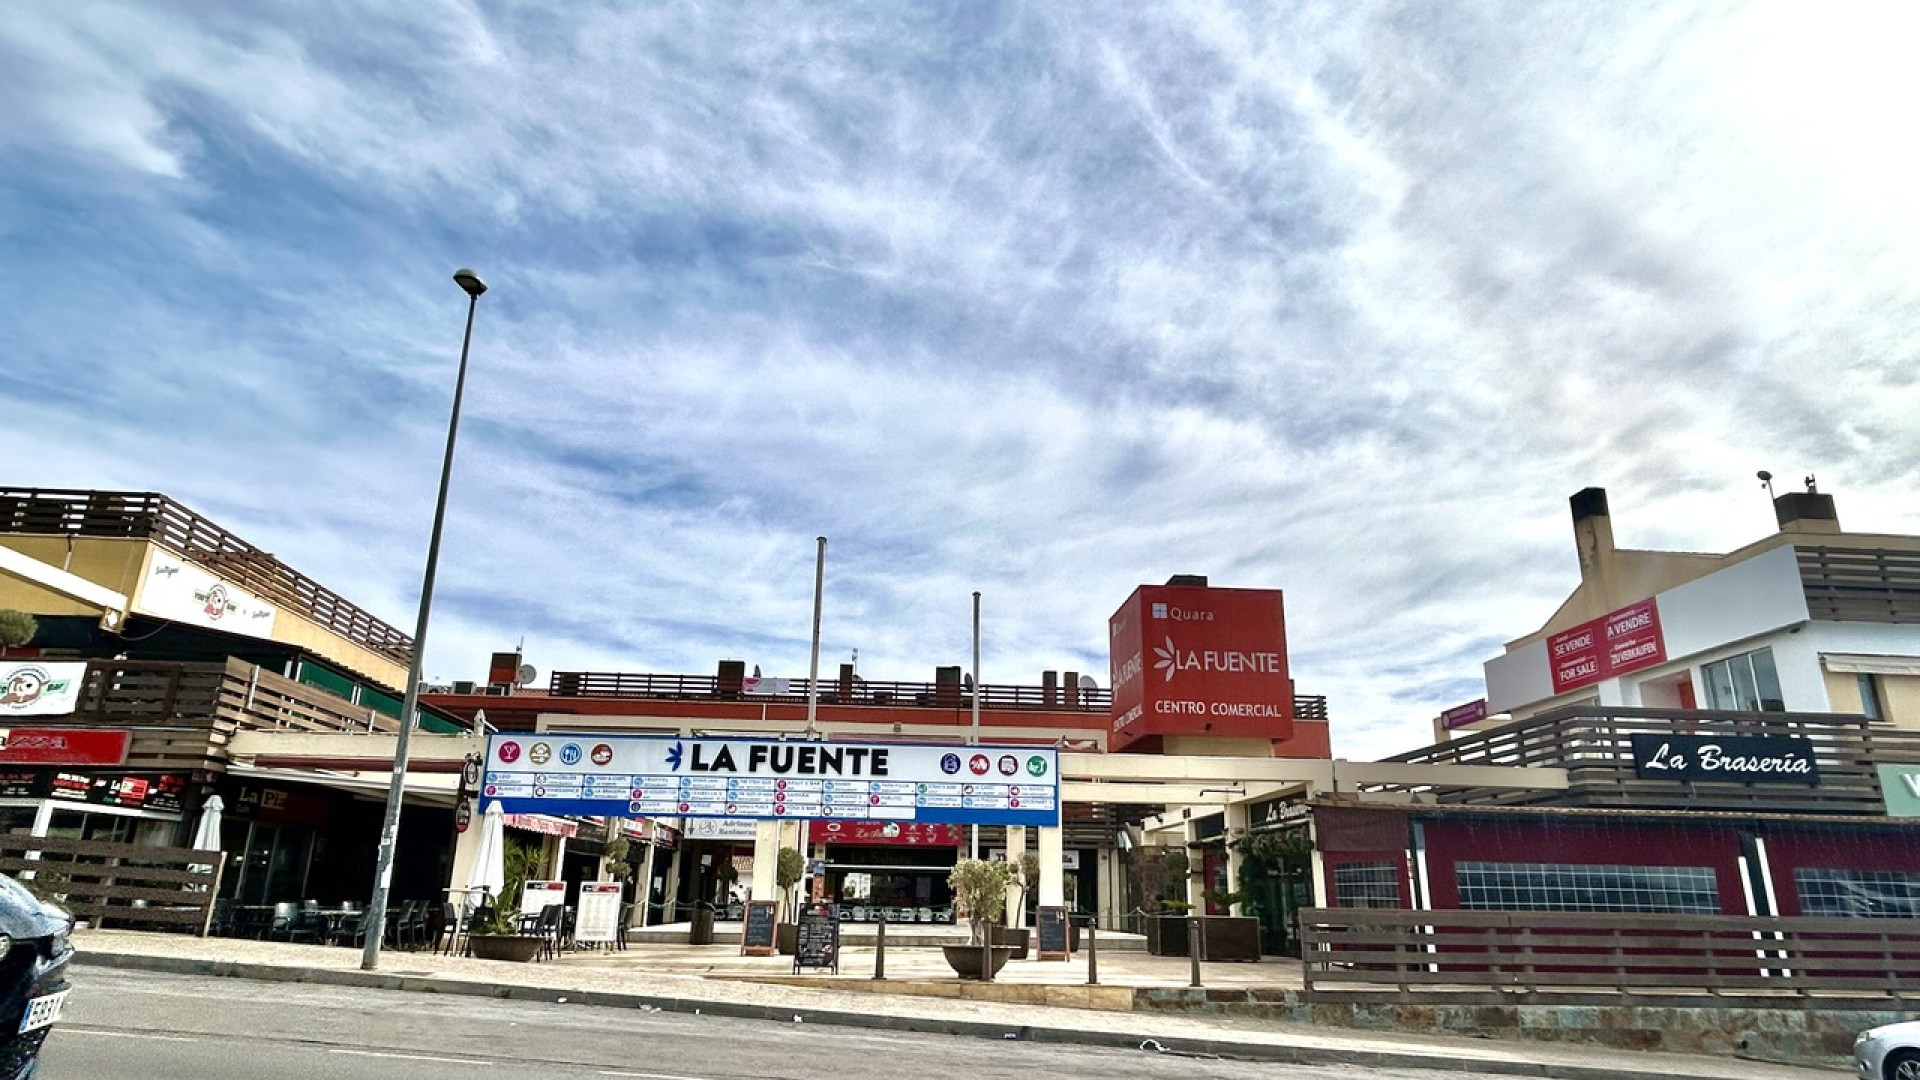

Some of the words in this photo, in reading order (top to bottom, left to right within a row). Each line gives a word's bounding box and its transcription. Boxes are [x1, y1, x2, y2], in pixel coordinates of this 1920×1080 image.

[1170, 607, 1213, 622] Quara
[1613, 612, 1651, 634] VENDRE
[1554, 643, 1566, 656] SE
[1564, 634, 1591, 651] VENDE
[1175, 650, 1201, 670] LA
[1204, 651, 1279, 673] FUENTE
[1560, 668, 1576, 681] FOR
[1577, 661, 1596, 676] SALE
[1155, 700, 1206, 715] CENTRO
[1210, 703, 1282, 718] COMERCIAL
[690, 743, 737, 771] LA
[748, 744, 889, 775] FUENTE
[1645, 743, 1689, 770] La
[1697, 744, 1811, 774] Brasería
